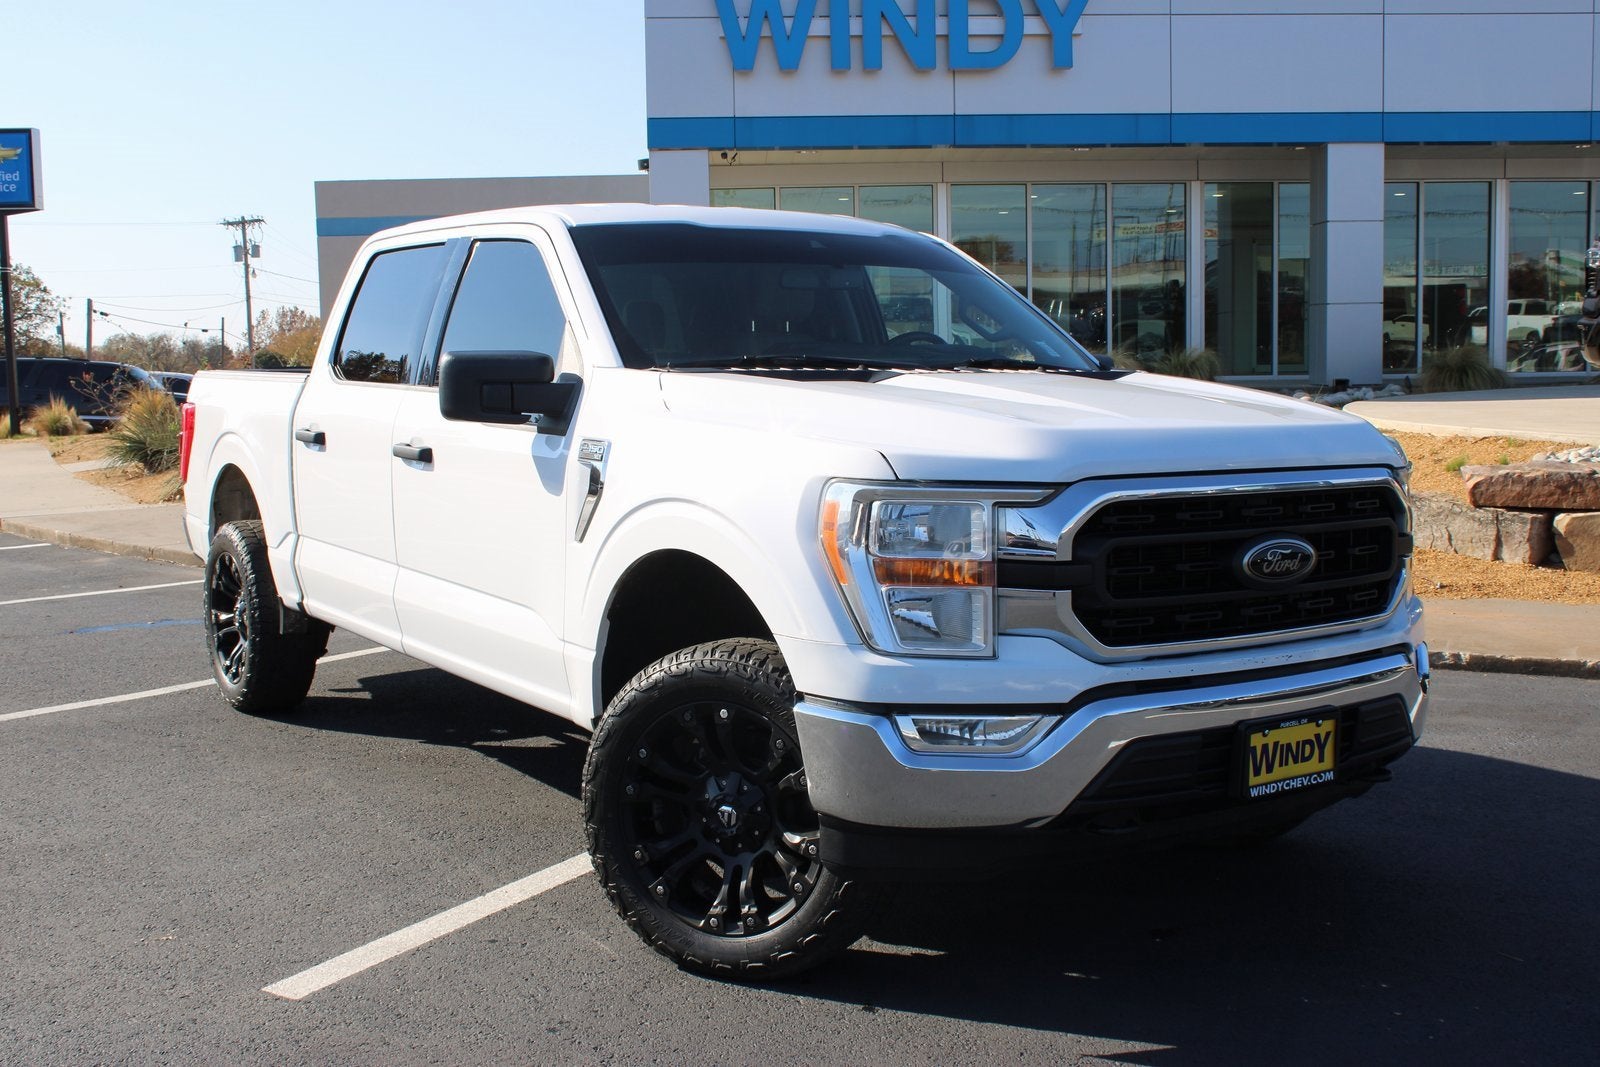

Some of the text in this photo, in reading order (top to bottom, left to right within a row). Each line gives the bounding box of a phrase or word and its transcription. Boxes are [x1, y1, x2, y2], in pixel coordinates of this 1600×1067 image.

[714, 0, 1088, 71] WINDY
[1263, 549, 1302, 573] Ford
[1250, 731, 1332, 778] WINDY
[1250, 771, 1334, 797] WINDYCHEV.COM
